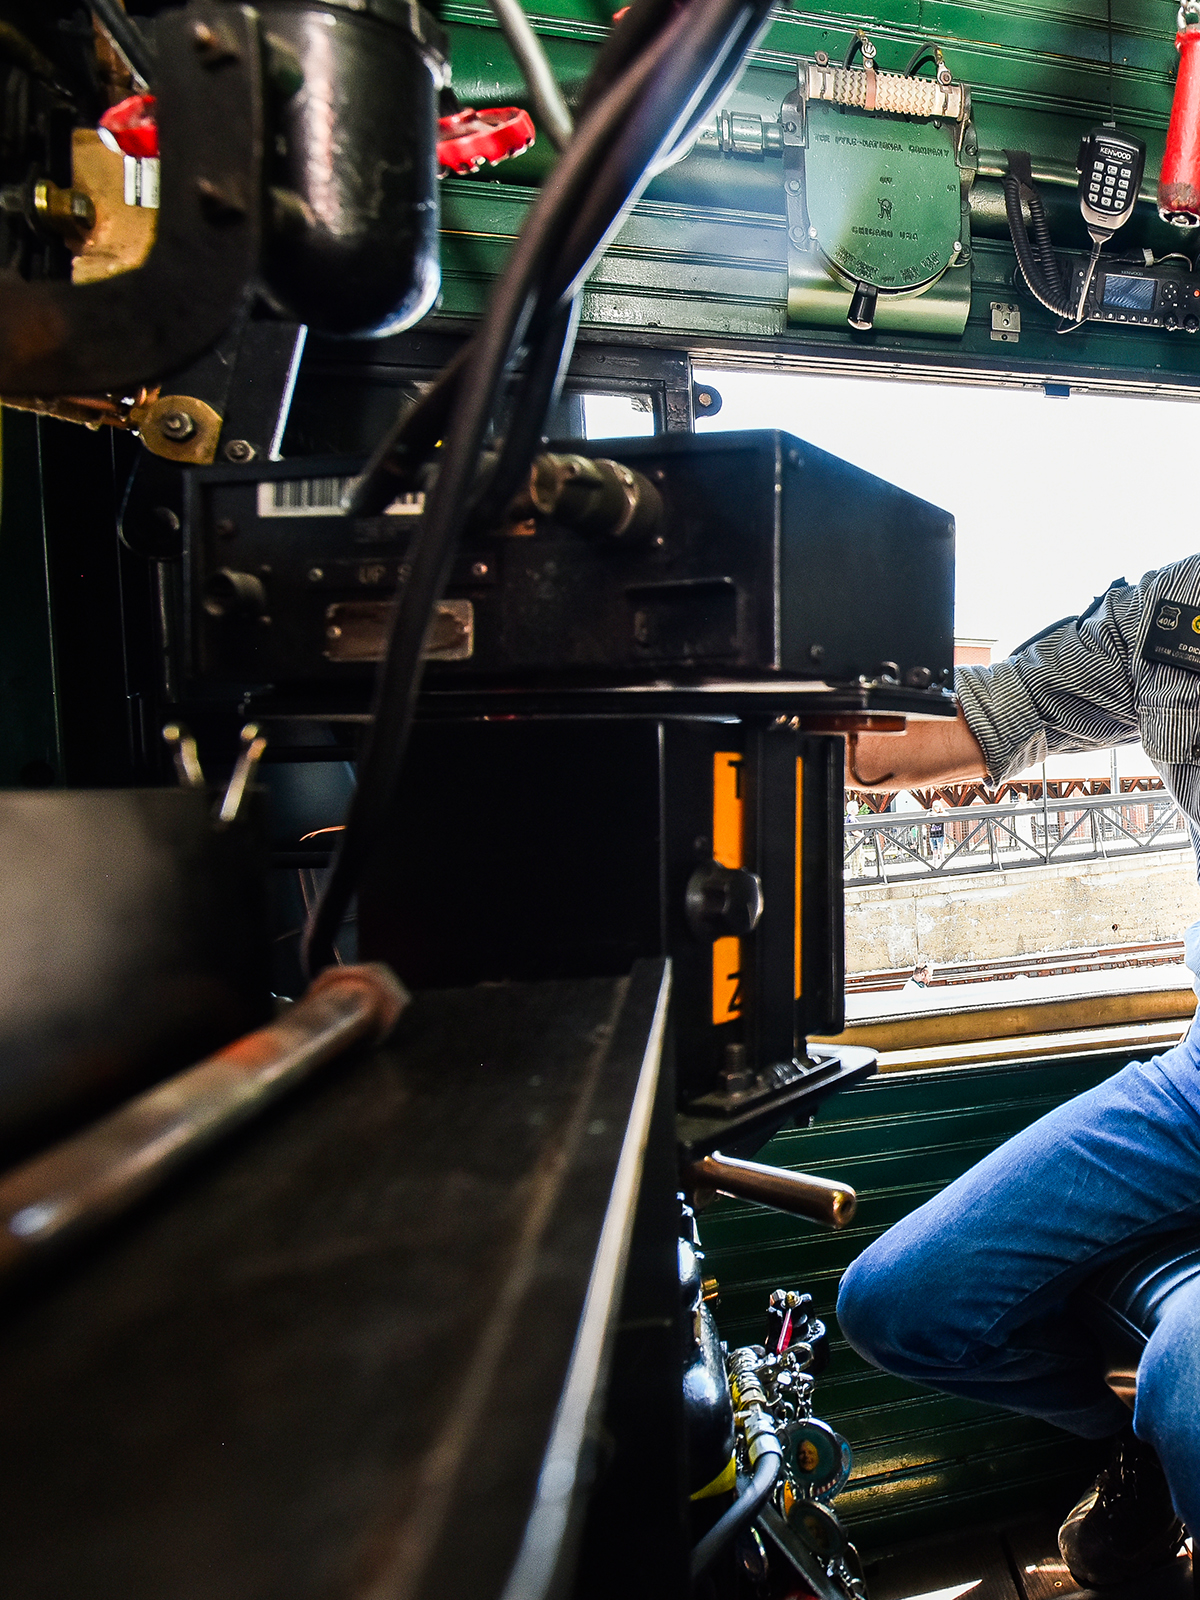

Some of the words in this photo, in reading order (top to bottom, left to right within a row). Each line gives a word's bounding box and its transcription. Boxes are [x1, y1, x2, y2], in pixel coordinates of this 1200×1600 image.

[1100, 147, 1132, 160] KENWOOD
[1158, 616, 1176, 628] 4014
[1178, 643, 1188, 651] ED
